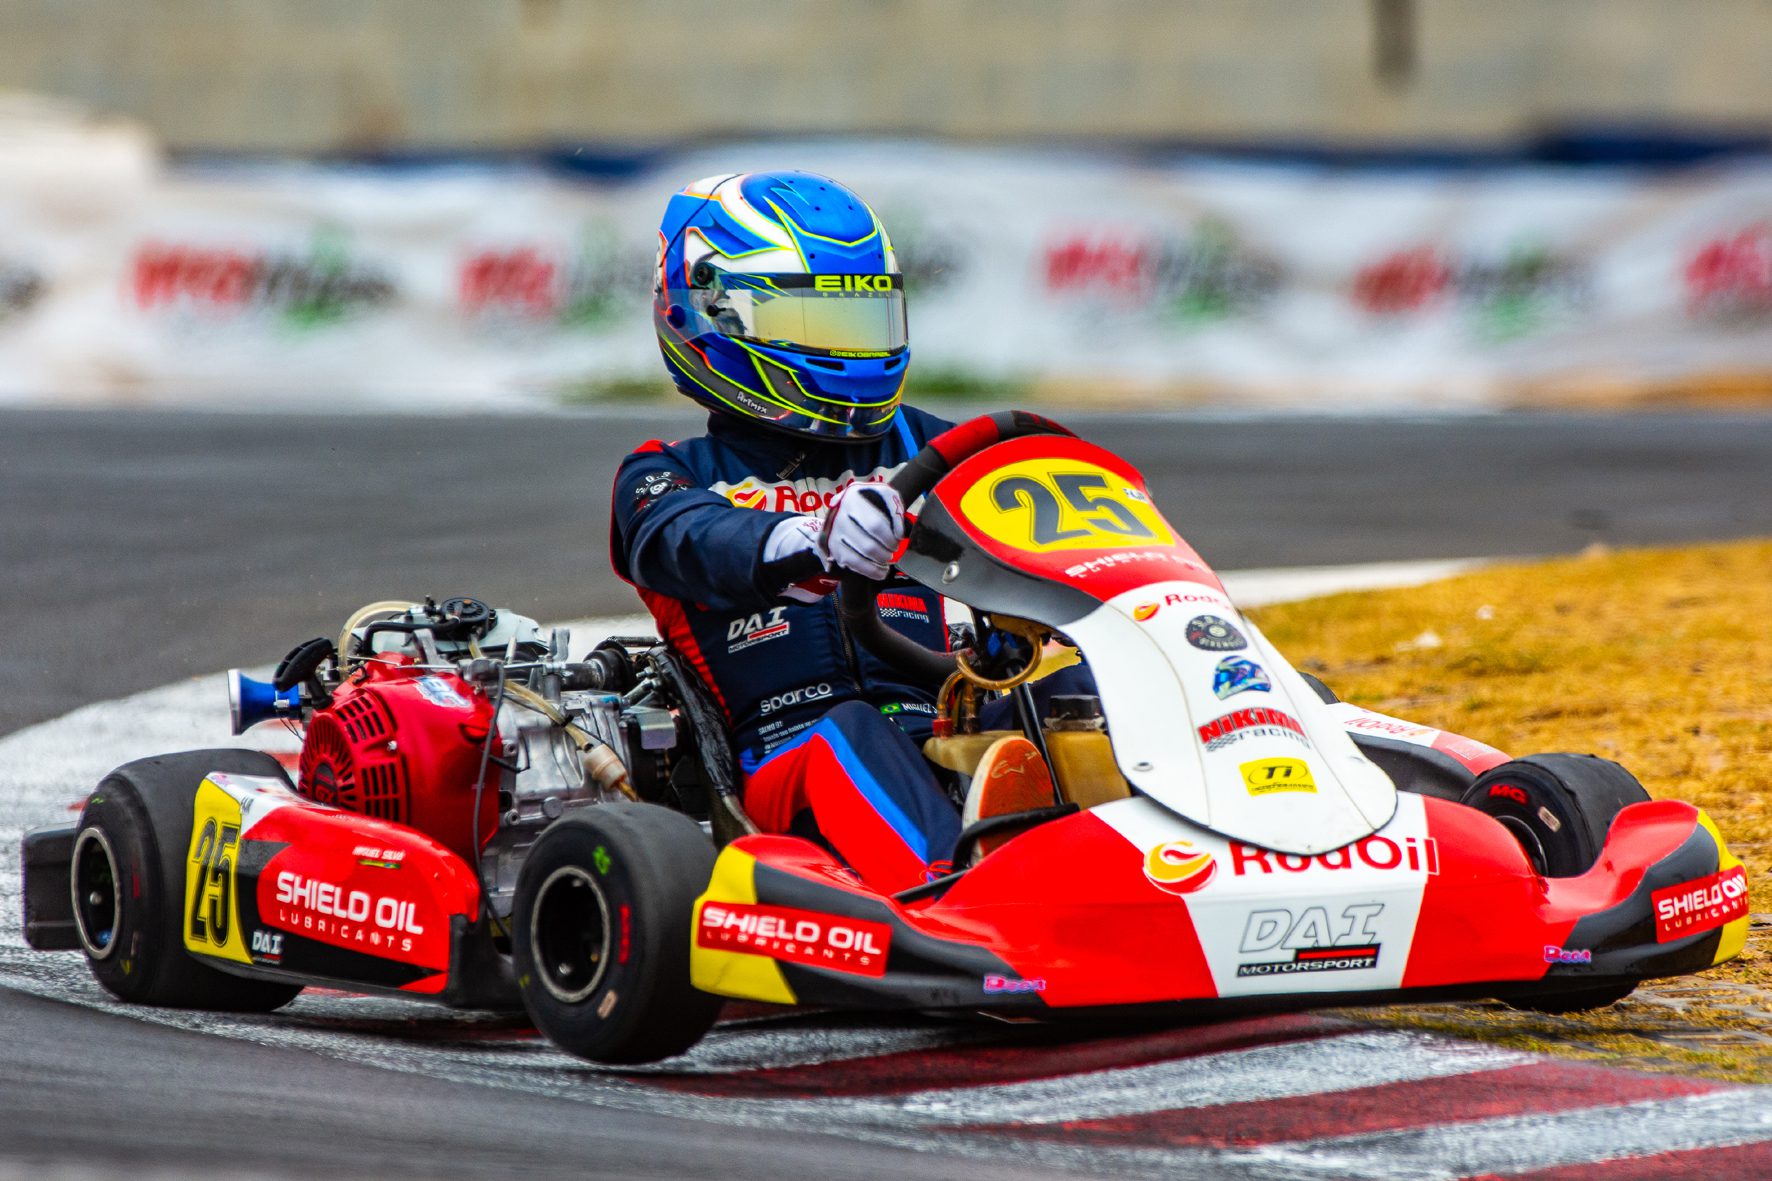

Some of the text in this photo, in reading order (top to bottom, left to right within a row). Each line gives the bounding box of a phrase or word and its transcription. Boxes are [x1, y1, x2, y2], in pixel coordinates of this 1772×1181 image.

[815, 275, 892, 292] EIKO
[989, 471, 1158, 547] 25
[727, 606, 788, 641] DAI
[897, 610, 930, 623] racing
[760, 683, 831, 713] sparco
[189, 817, 240, 948] 25
[1658, 874, 1748, 920] SHIELD OIL
[276, 870, 424, 935] SHIELD OIL
[252, 931, 281, 955] DAI
[280, 909, 412, 952] LUBRICANTS
[703, 906, 881, 955] SHIELD OIL
[1239, 903, 1385, 953] DAI
[706, 931, 870, 965] LUBRICANTS
[1240, 957, 1375, 974] MOTORSPORT
